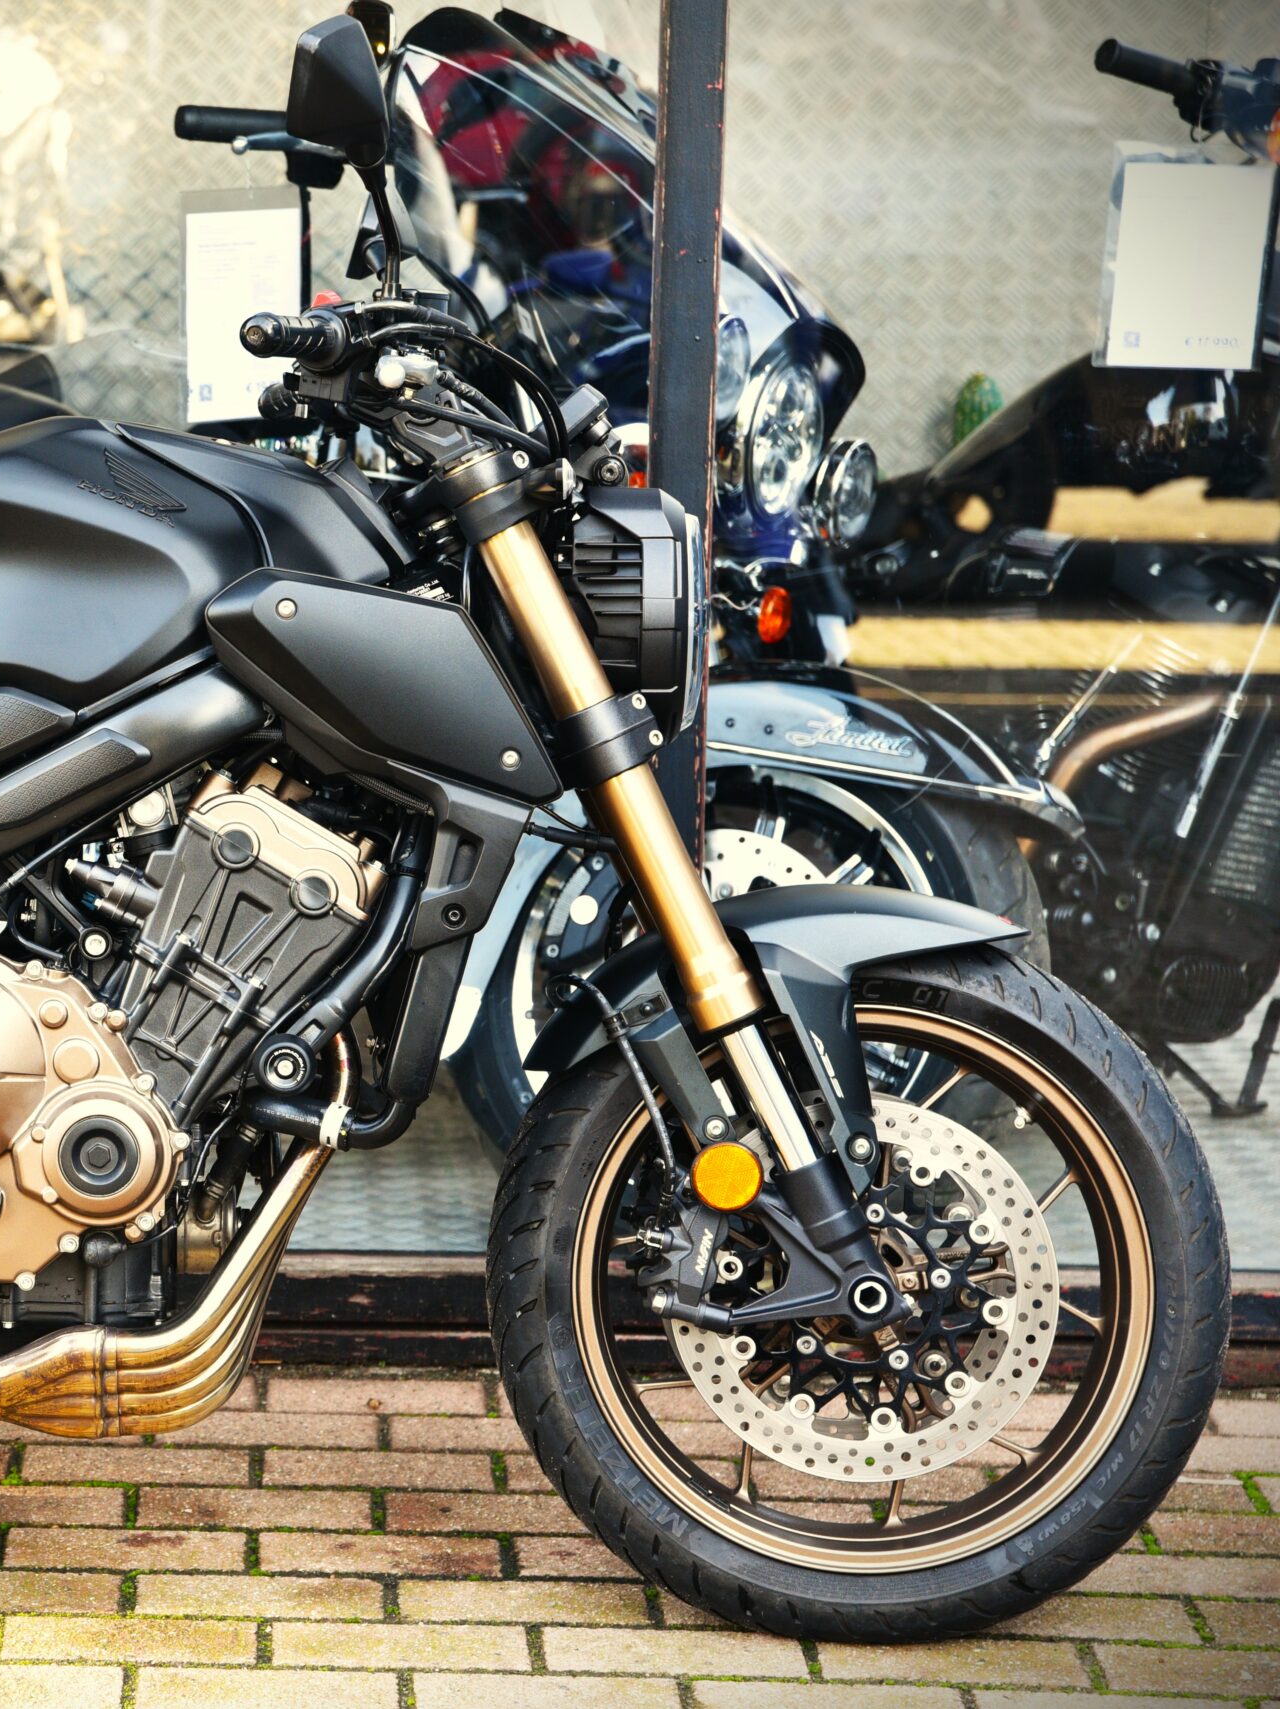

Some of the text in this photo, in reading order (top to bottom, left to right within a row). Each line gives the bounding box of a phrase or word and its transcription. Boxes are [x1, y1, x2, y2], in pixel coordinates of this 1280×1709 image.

[76, 480, 175, 528] HONDA
[809, 1030, 845, 1099] ABS
[558, 1362, 688, 1538] METZELER
